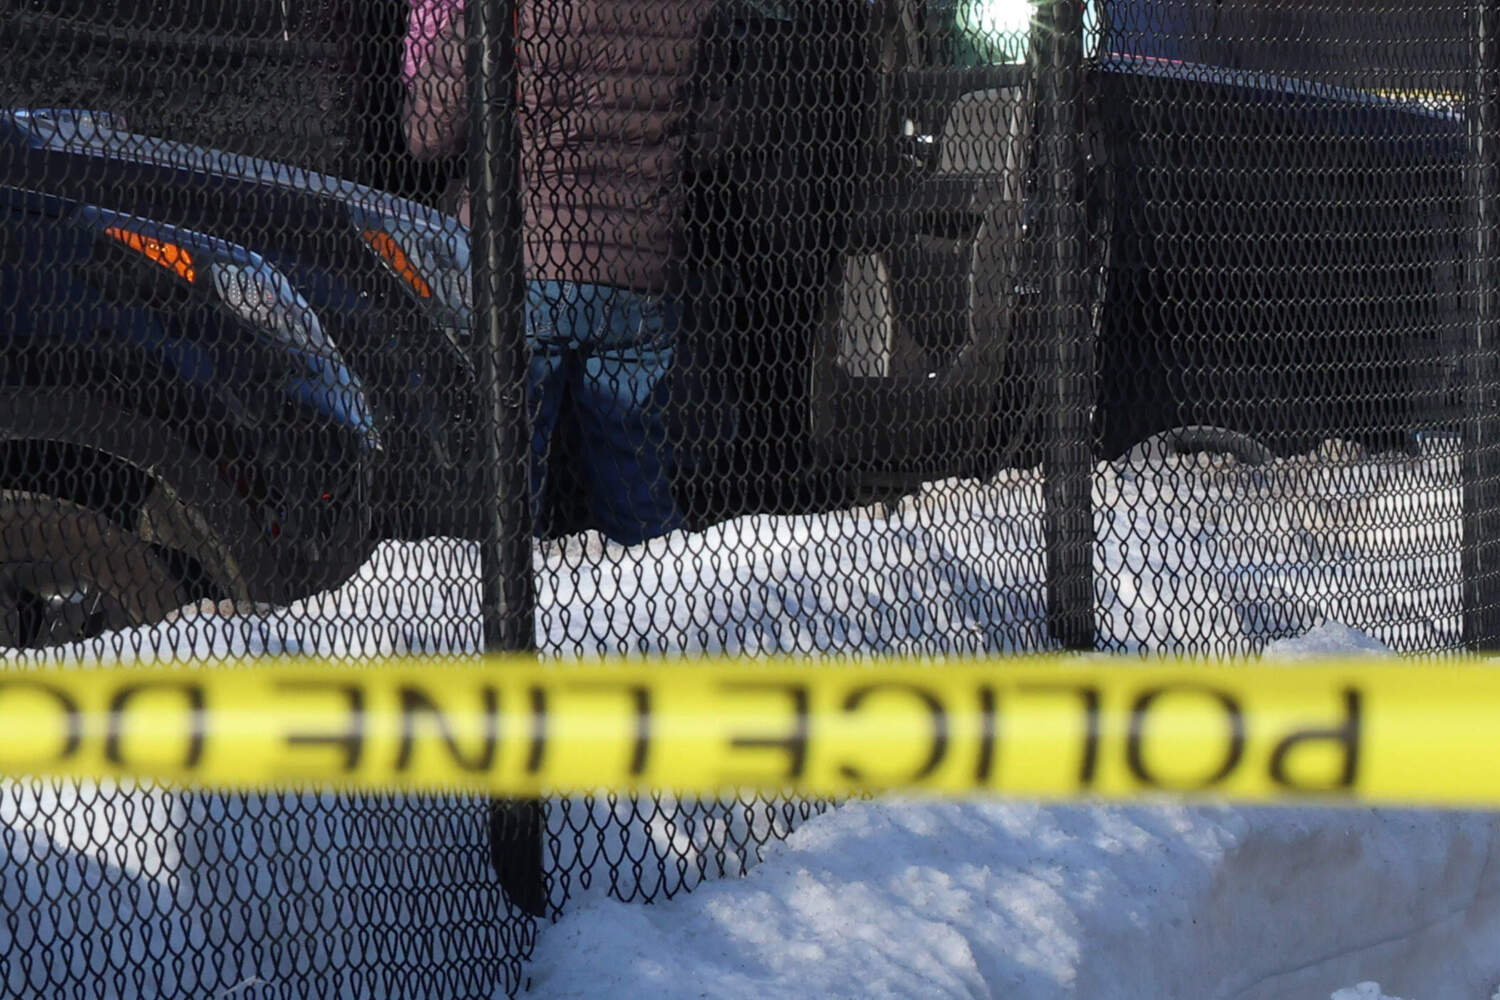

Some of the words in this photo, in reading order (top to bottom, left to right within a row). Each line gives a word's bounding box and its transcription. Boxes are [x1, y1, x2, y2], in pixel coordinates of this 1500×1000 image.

[0, 676, 207, 772] DO
[264, 678, 655, 780] LINE
[713, 680, 1366, 796] POLICE
